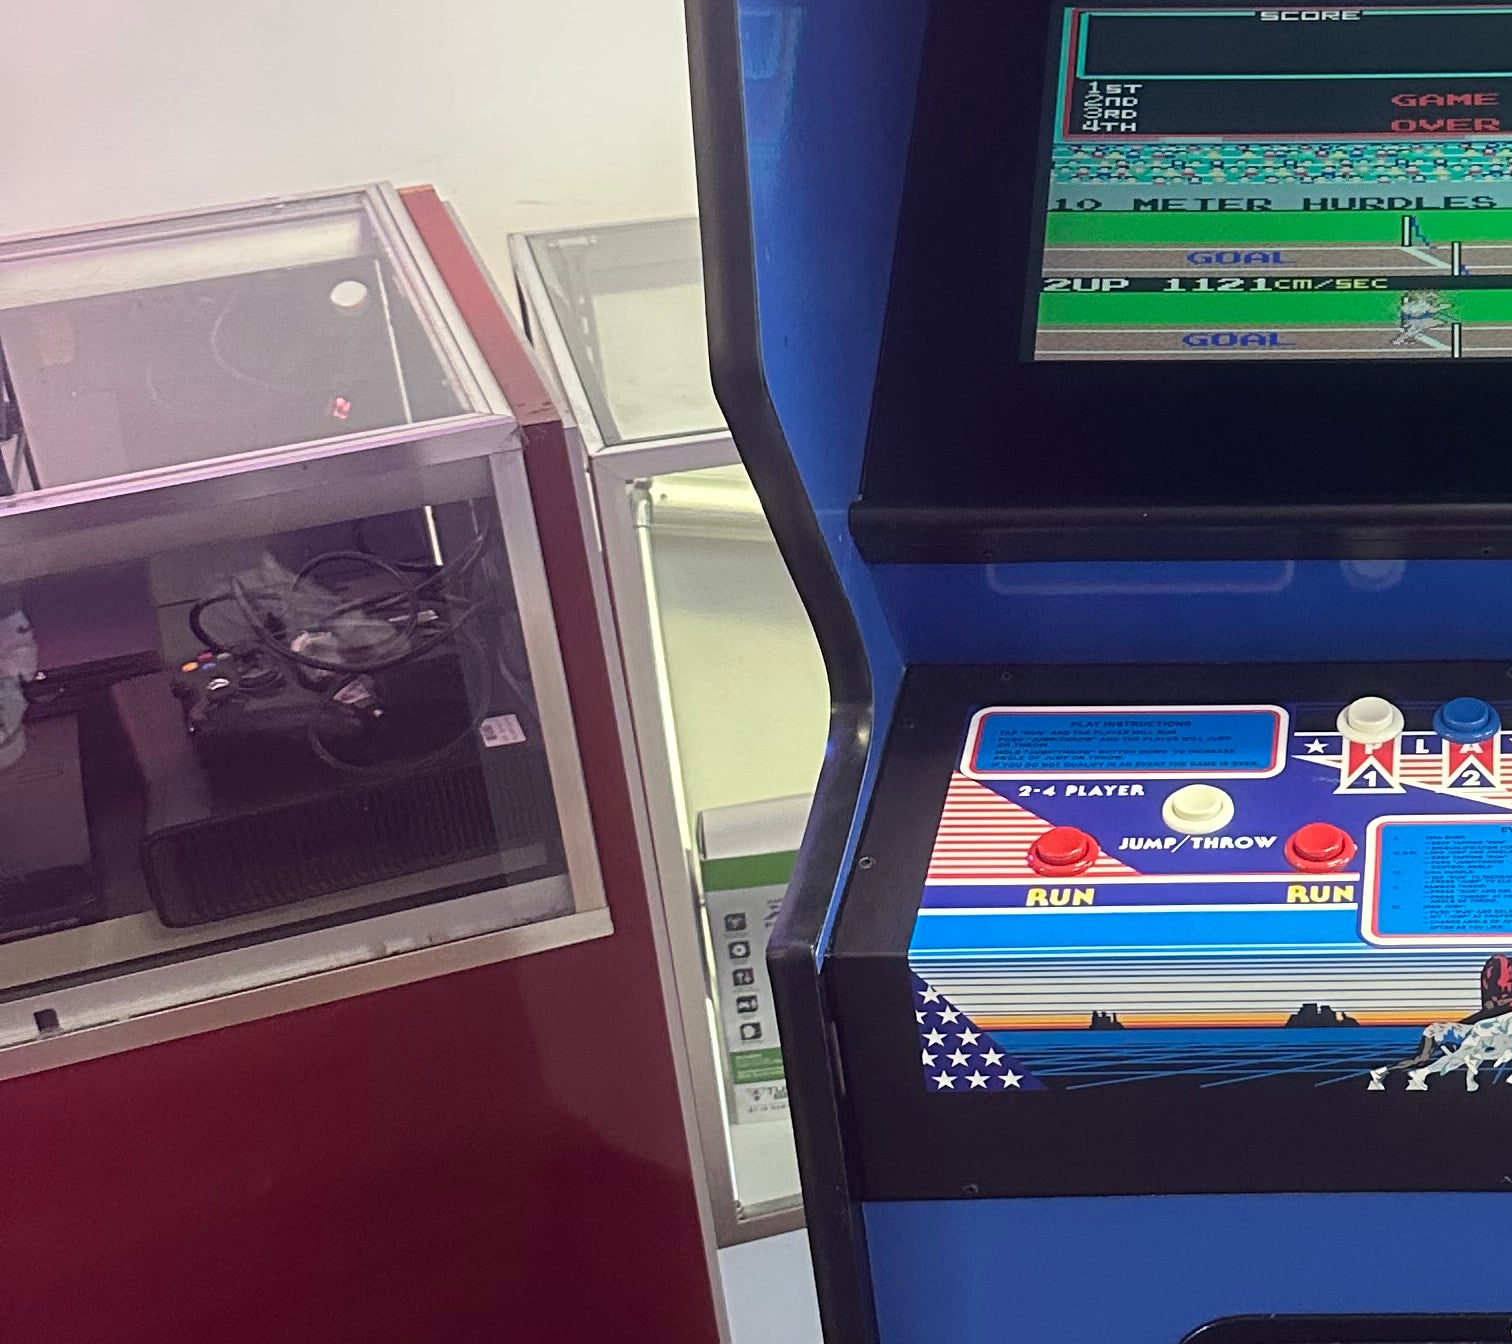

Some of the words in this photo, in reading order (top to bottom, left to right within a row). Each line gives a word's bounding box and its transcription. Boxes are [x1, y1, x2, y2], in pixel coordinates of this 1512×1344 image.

[1259, 9, 1363, 22] SCORE
[1088, 81, 1143, 95] 1ST
[1083, 95, 1139, 107] 2ND
[1391, 92, 1500, 107] GAME
[1083, 107, 1137, 120] 3RD
[1082, 120, 1137, 133] 4TH
[1391, 117, 1501, 132] OVER
[1133, 197, 1273, 212] METER
[1303, 195, 1498, 211] HURDLES
[1186, 250, 1298, 265] GOAL
[1042, 277, 1131, 293] 2UP
[1181, 331, 1297, 348] GOAL
[1363, 770, 1377, 787] 1
[1462, 770, 1482, 786] 2
[1018, 785, 1058, 798] 2-4
[1066, 784, 1145, 798] PLAYER
[1118, 834, 1278, 853] JUMP/THROW
[1025, 887, 1096, 907] RUN
[1286, 884, 1356, 904] RUN
